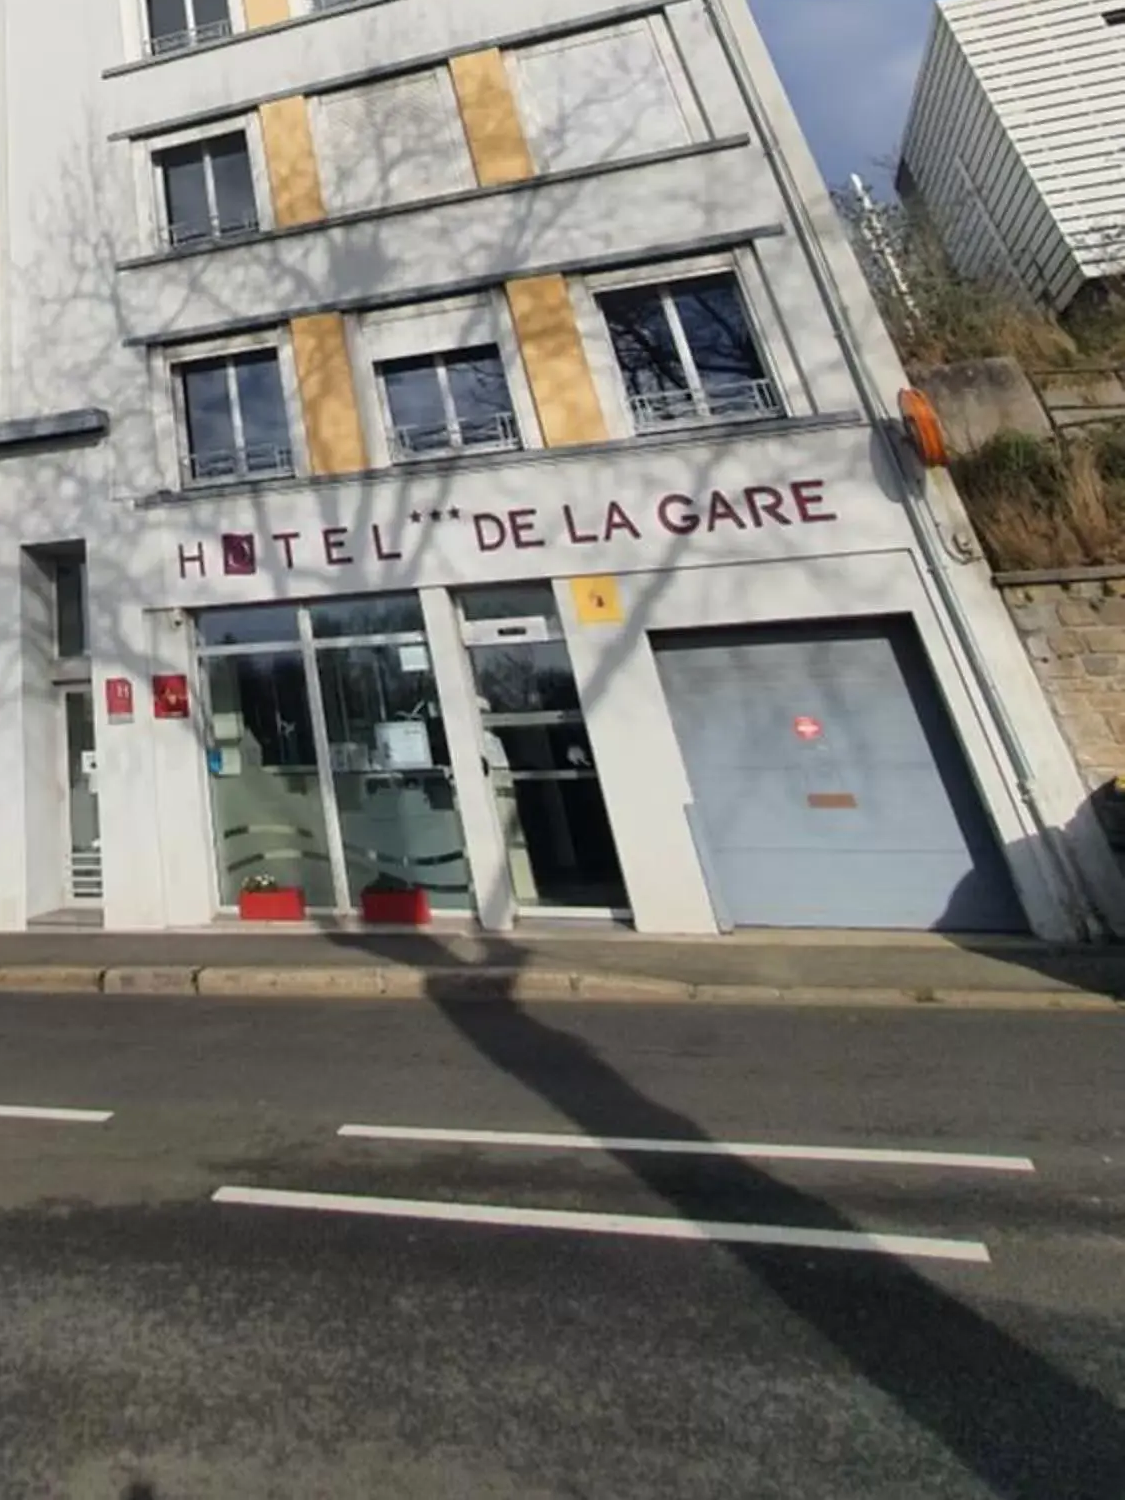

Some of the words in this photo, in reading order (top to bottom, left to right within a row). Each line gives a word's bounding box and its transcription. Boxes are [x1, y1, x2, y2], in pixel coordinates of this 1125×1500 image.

[178, 523, 402, 578] HOTEL
[475, 509, 545, 552] DE
[563, 501, 641, 543] LA
[657, 479, 837, 536] GARE
